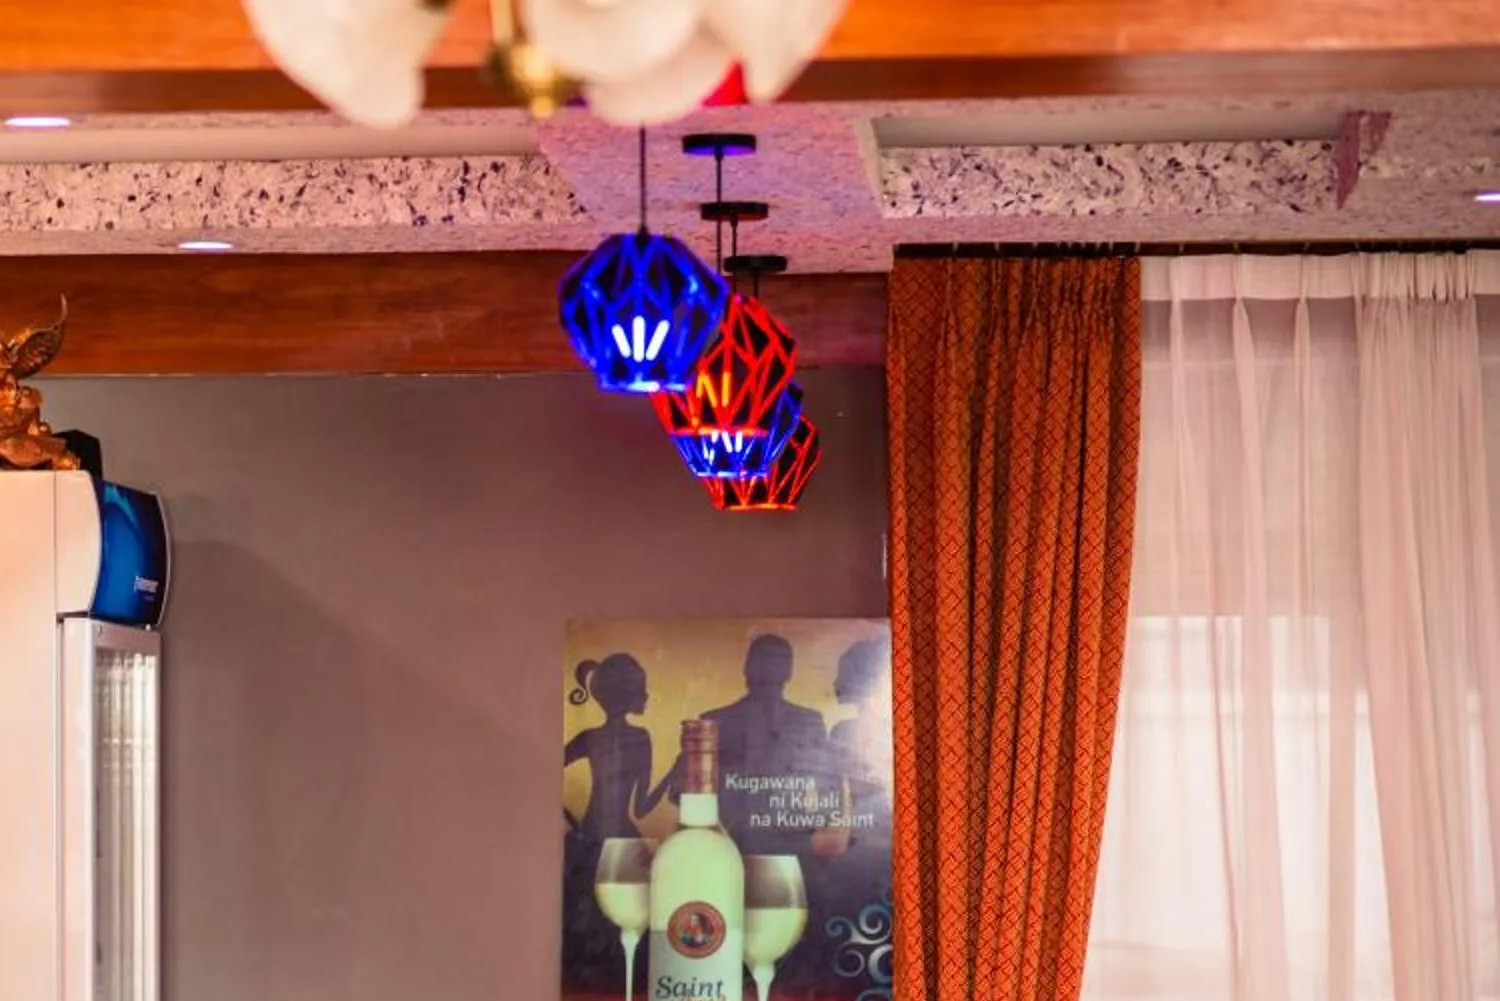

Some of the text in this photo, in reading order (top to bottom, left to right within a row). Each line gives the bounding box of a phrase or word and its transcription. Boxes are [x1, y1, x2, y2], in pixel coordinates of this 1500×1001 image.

[725, 773, 816, 793] Kugawana
[769, 793, 785, 809] ni
[750, 811, 875, 827] na Kuwa Saint
[655, 975, 725, 999] Saint
